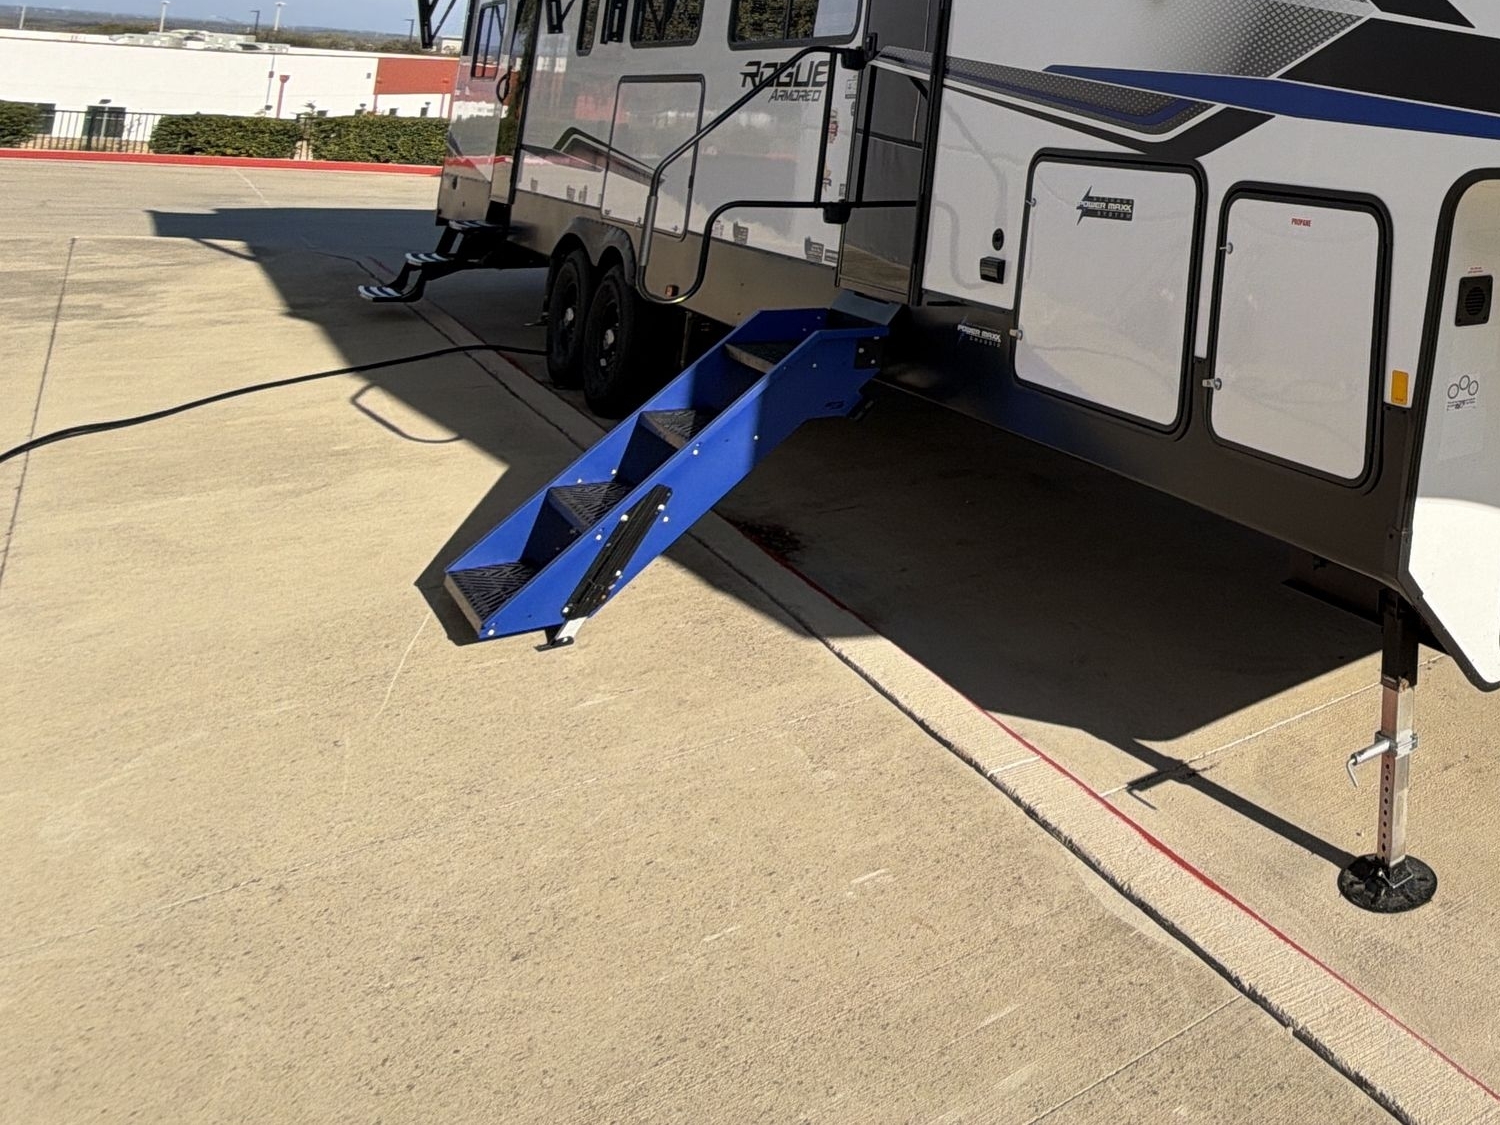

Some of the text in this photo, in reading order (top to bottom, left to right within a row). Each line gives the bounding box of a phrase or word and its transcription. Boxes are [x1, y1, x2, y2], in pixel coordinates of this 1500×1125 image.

[740, 61, 829, 87] ROGUE
[768, 89, 821, 103] ARMORED
[1080, 201, 1132, 213] POWER MAXX
[957, 324, 980, 337] POWER
[981, 330, 1001, 343] MAXX
